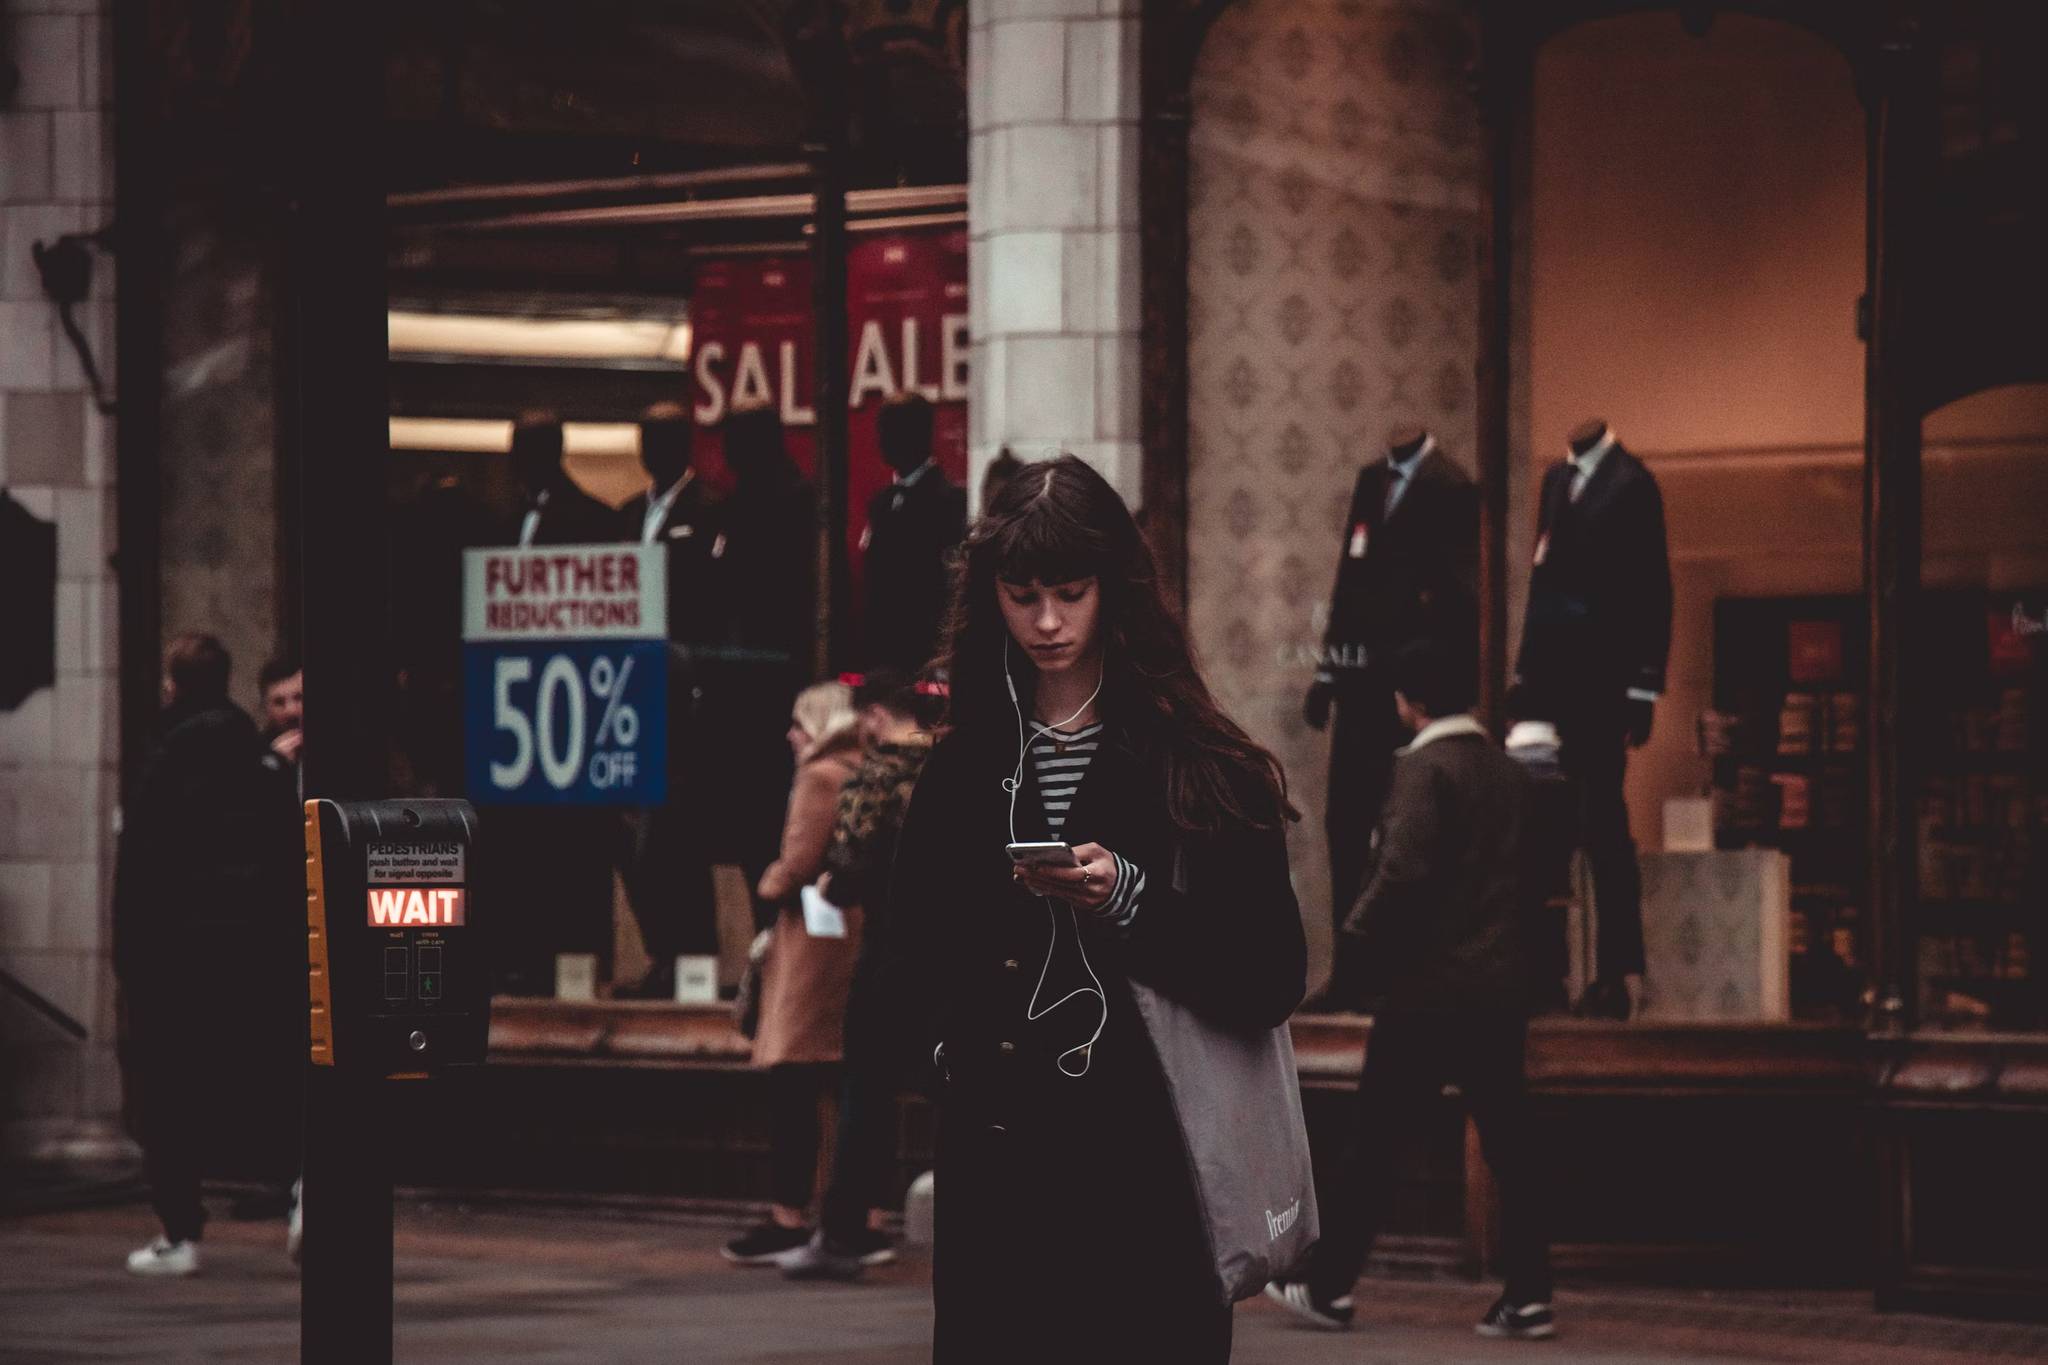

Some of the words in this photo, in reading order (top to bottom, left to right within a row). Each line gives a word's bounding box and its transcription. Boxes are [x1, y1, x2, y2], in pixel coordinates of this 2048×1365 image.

[847, 311, 969, 408] ALE
[693, 340, 817, 425] SAL
[485, 552, 640, 596] FURTHER
[485, 598, 642, 630] REDUCTIONS
[489, 653, 640, 790] 50%
[588, 751, 638, 790] OFF
[369, 842, 459, 855] PEDESTRIANS
[369, 857, 391, 869] push
[392, 857, 420, 867] button
[422, 857, 438, 867] and
[440, 857, 459, 867] wait
[374, 869, 386, 878] for
[388, 869, 414, 880] signal
[415, 869, 453, 880] opposite
[369, 890, 459, 924] WAIT
